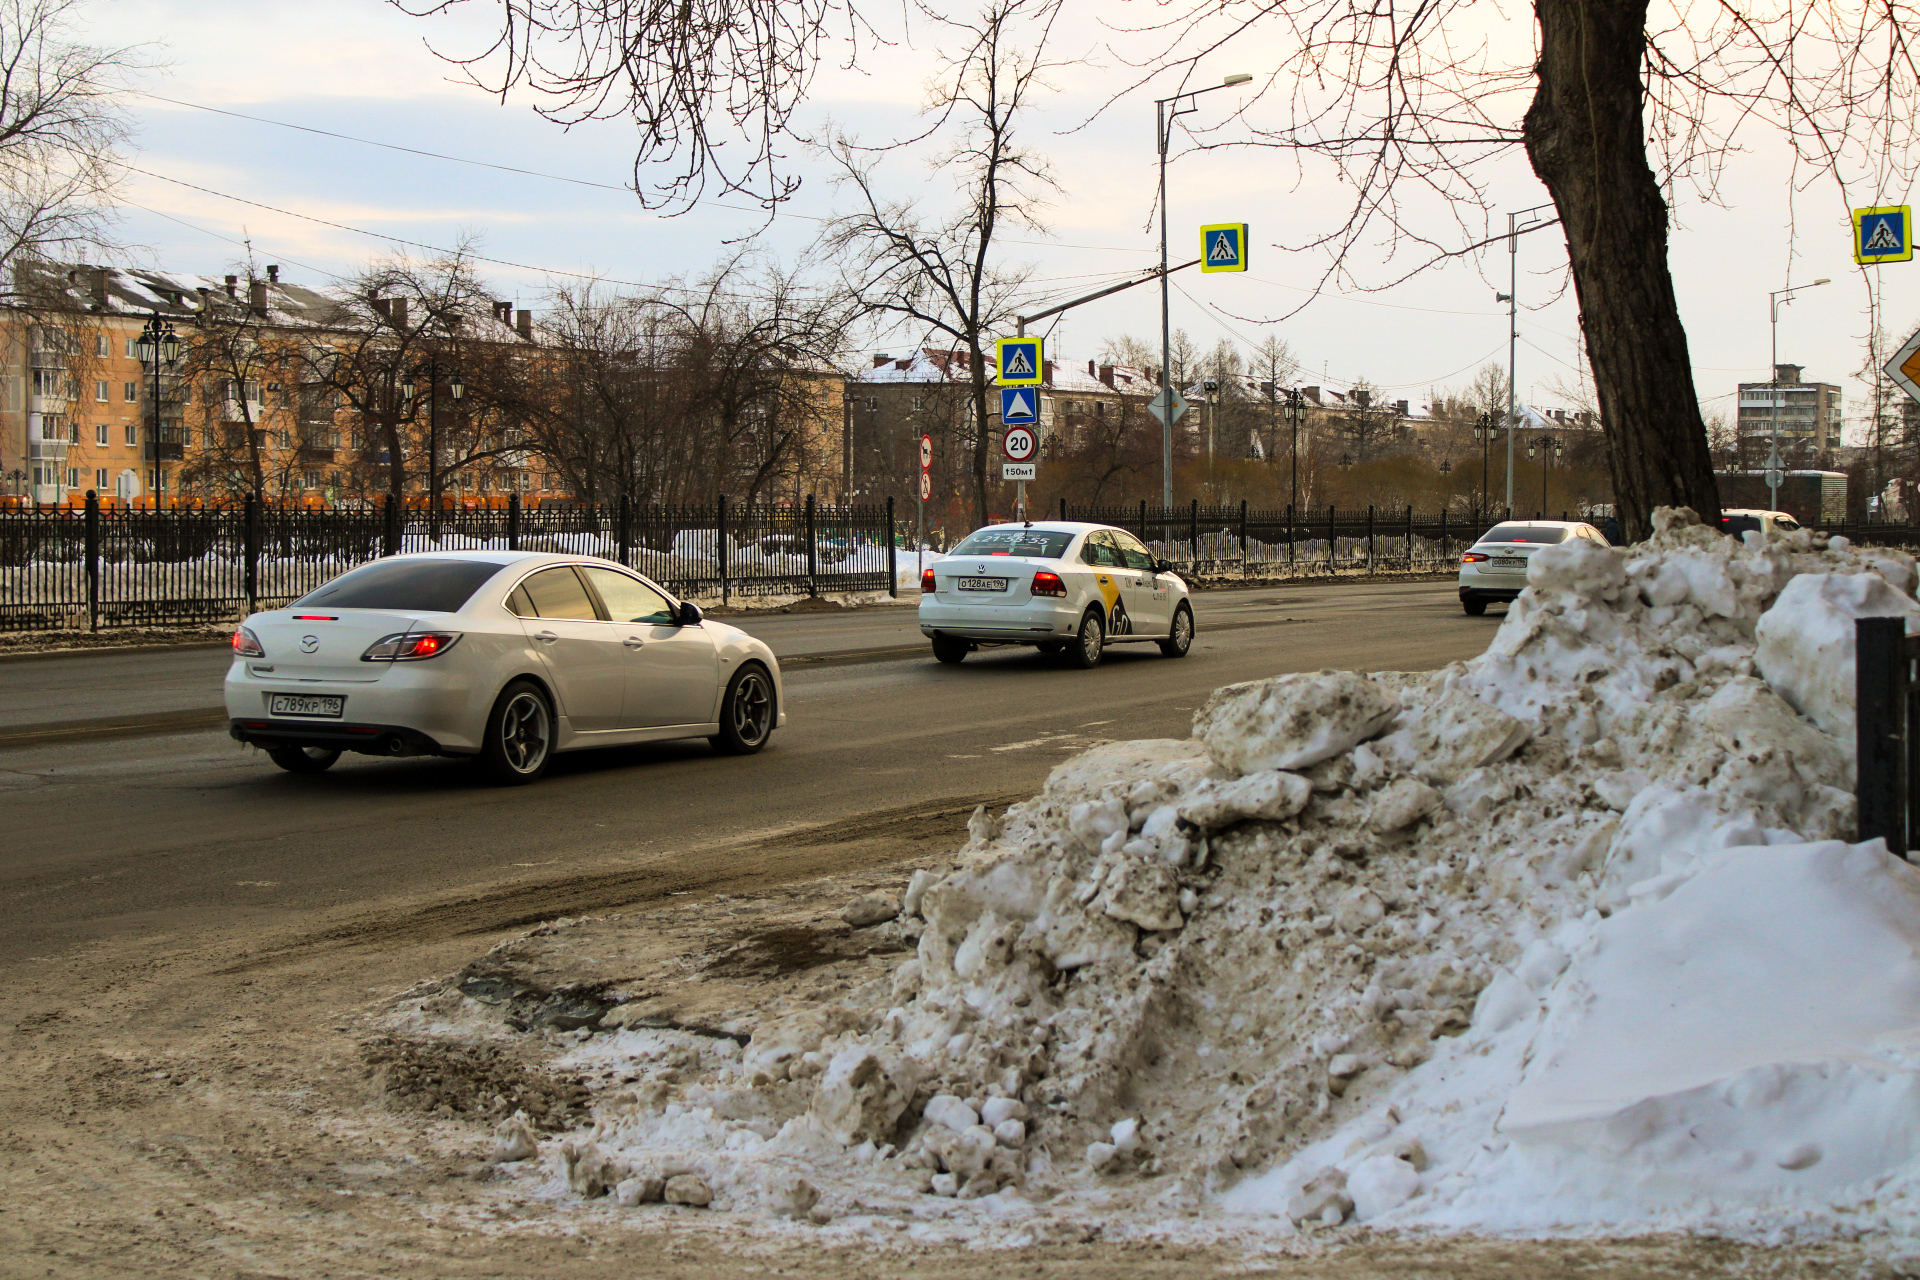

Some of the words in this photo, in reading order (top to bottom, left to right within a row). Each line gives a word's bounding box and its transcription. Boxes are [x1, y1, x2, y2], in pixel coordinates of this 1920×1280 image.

[1010, 436, 1028, 451] 20
[275, 697, 319, 712] С789КР
[321, 698, 340, 709] 196
